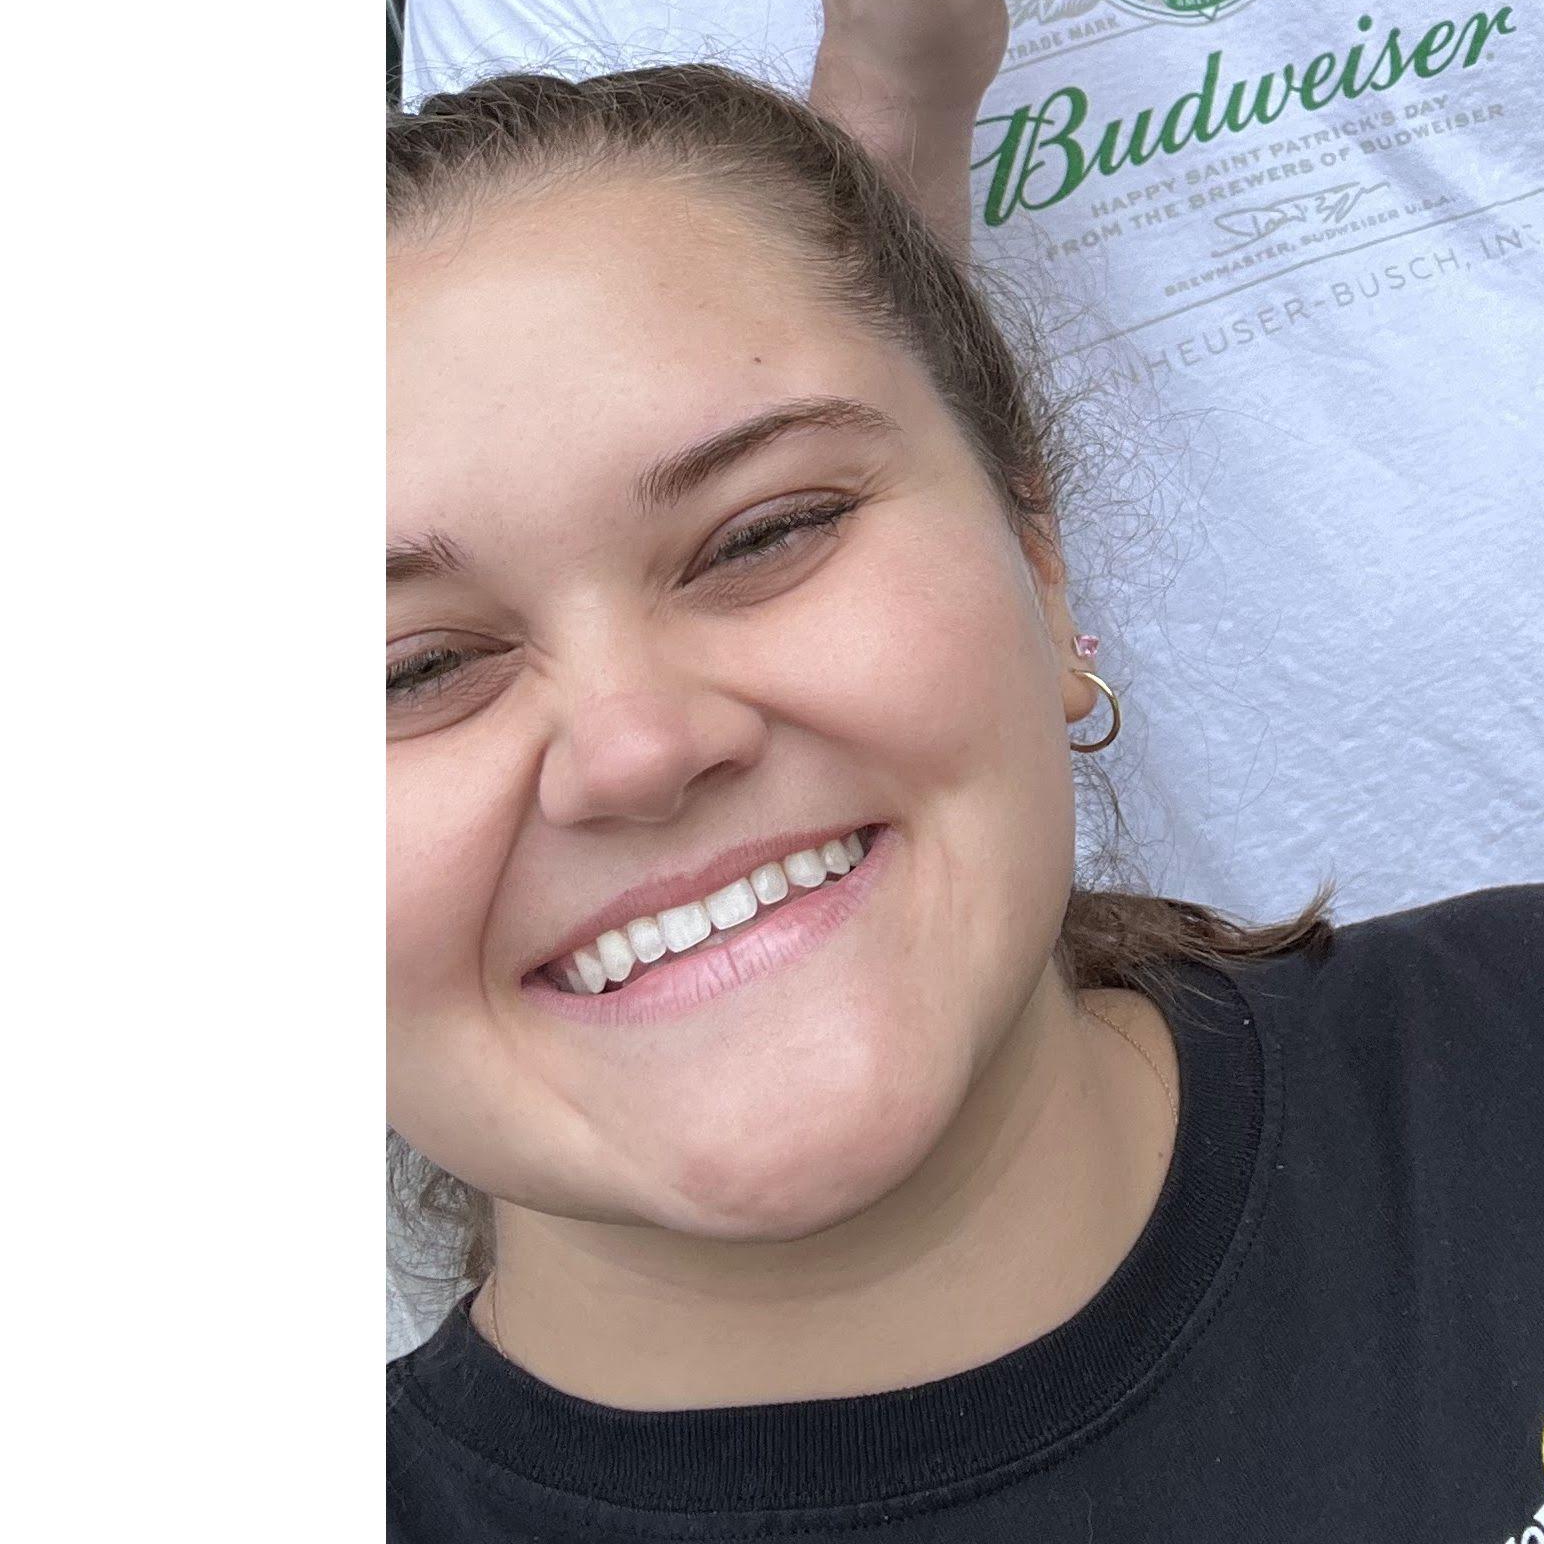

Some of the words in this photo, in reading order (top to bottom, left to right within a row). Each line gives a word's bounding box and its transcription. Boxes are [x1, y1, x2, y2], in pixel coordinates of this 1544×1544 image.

[1007, 31, 1063, 60] TRADE
[1068, 16, 1119, 40] MARK
[970, 5, 1517, 227] Budweiser
[1047, 220, 1123, 259] FROM
[1129, 203, 1181, 230] THE
[1188, 158, 1315, 210] BREWERS
[1320, 146, 1350, 167] OF
[1360, 103, 1505, 155] BUDWEISER
[1091, 177, 1176, 218] HAPPY
[1185, 148, 1261, 186] SAINT
[1269, 110, 1397, 159] PATRICK'S
[1405, 94, 1449, 120] DAY
[1107, 248, 1472, 386] NHEUSER-BUSCH,
[1164, 241, 1297, 298] BREWMASTER,
[1301, 209, 1400, 246] BUDWEISER
